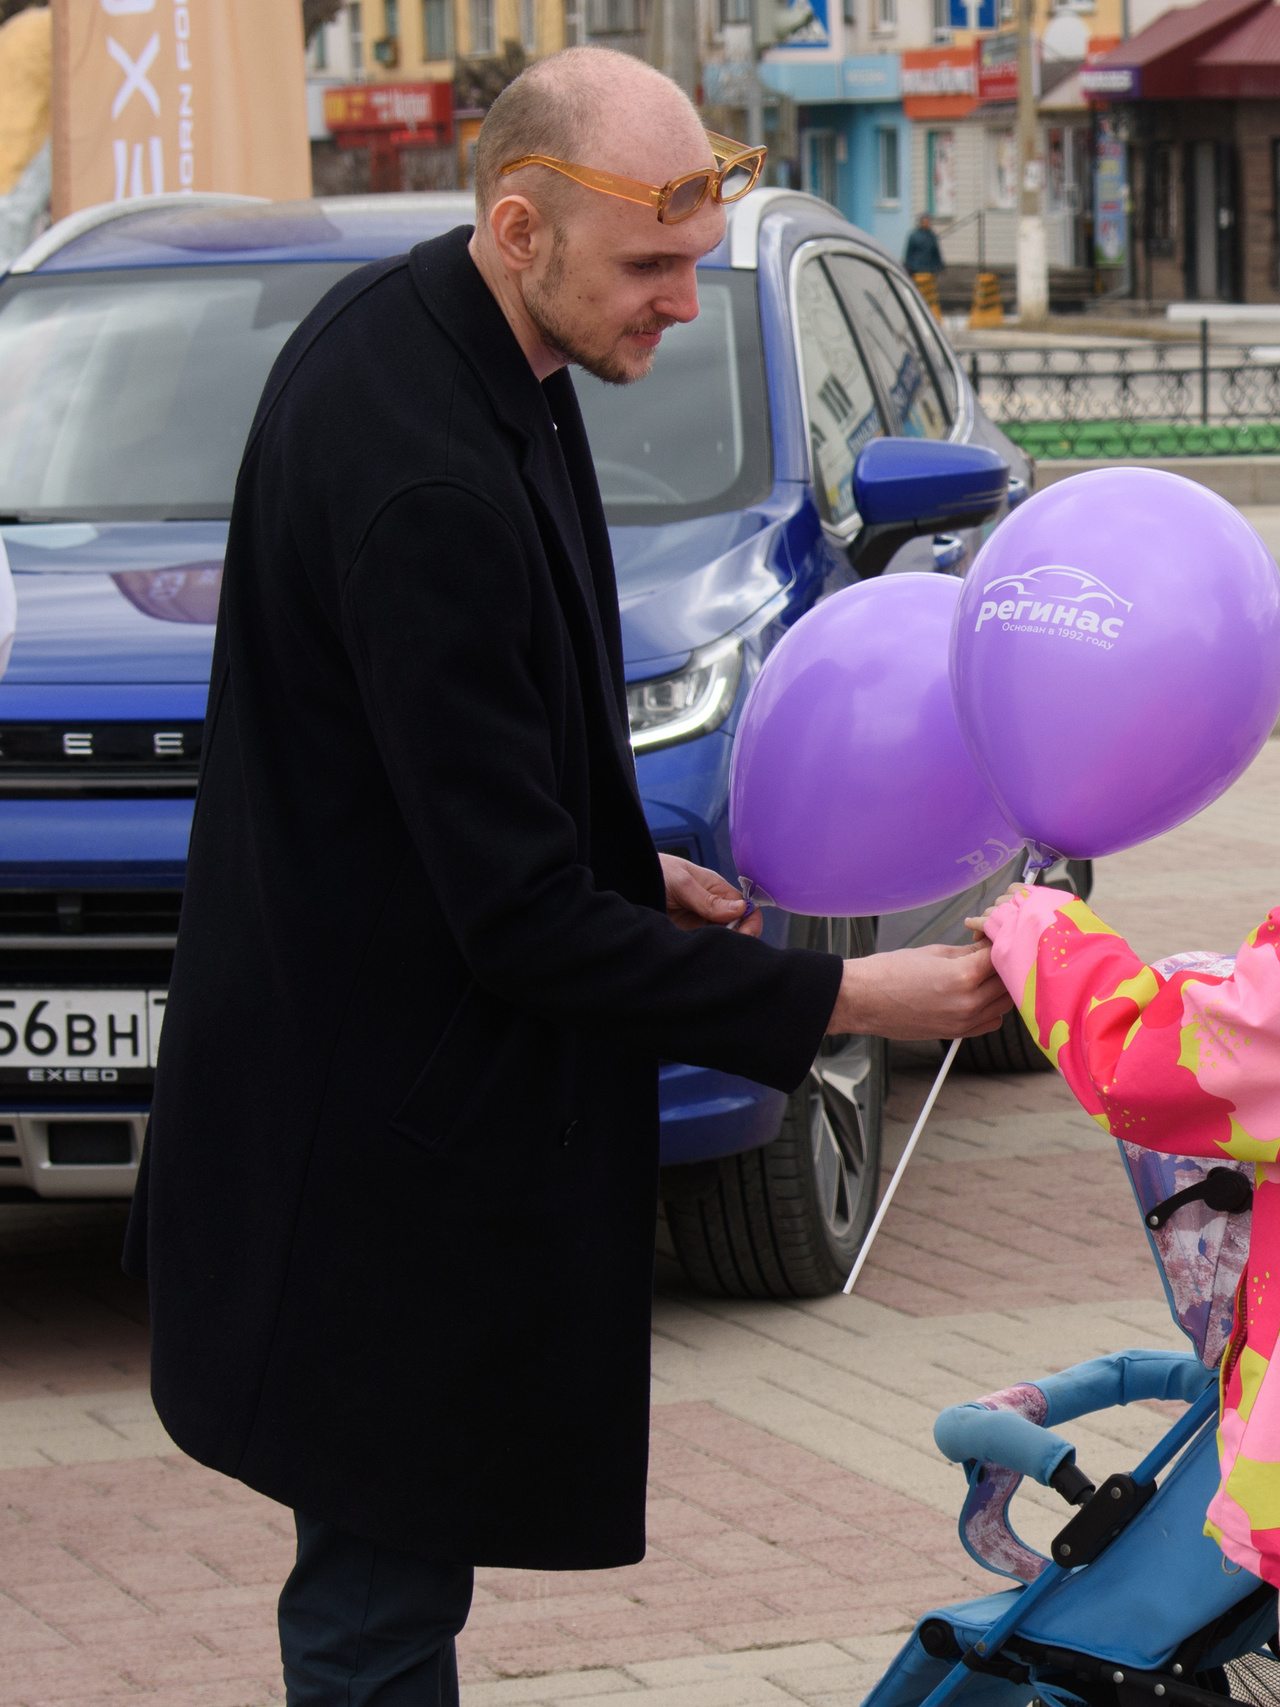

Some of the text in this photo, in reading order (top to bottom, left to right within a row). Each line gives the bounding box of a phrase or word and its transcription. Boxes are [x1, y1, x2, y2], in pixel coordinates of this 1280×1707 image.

[103, 0, 165, 200] EX
[173, 0, 194, 194] ORN FO
[975, 600, 1124, 638] регинас
[1002, 622, 1046, 635] Основан
[1058, 627, 1084, 642] 1992
[1085, 635, 1115, 650] году
[28, 1068, 118, 1082] EXEED
